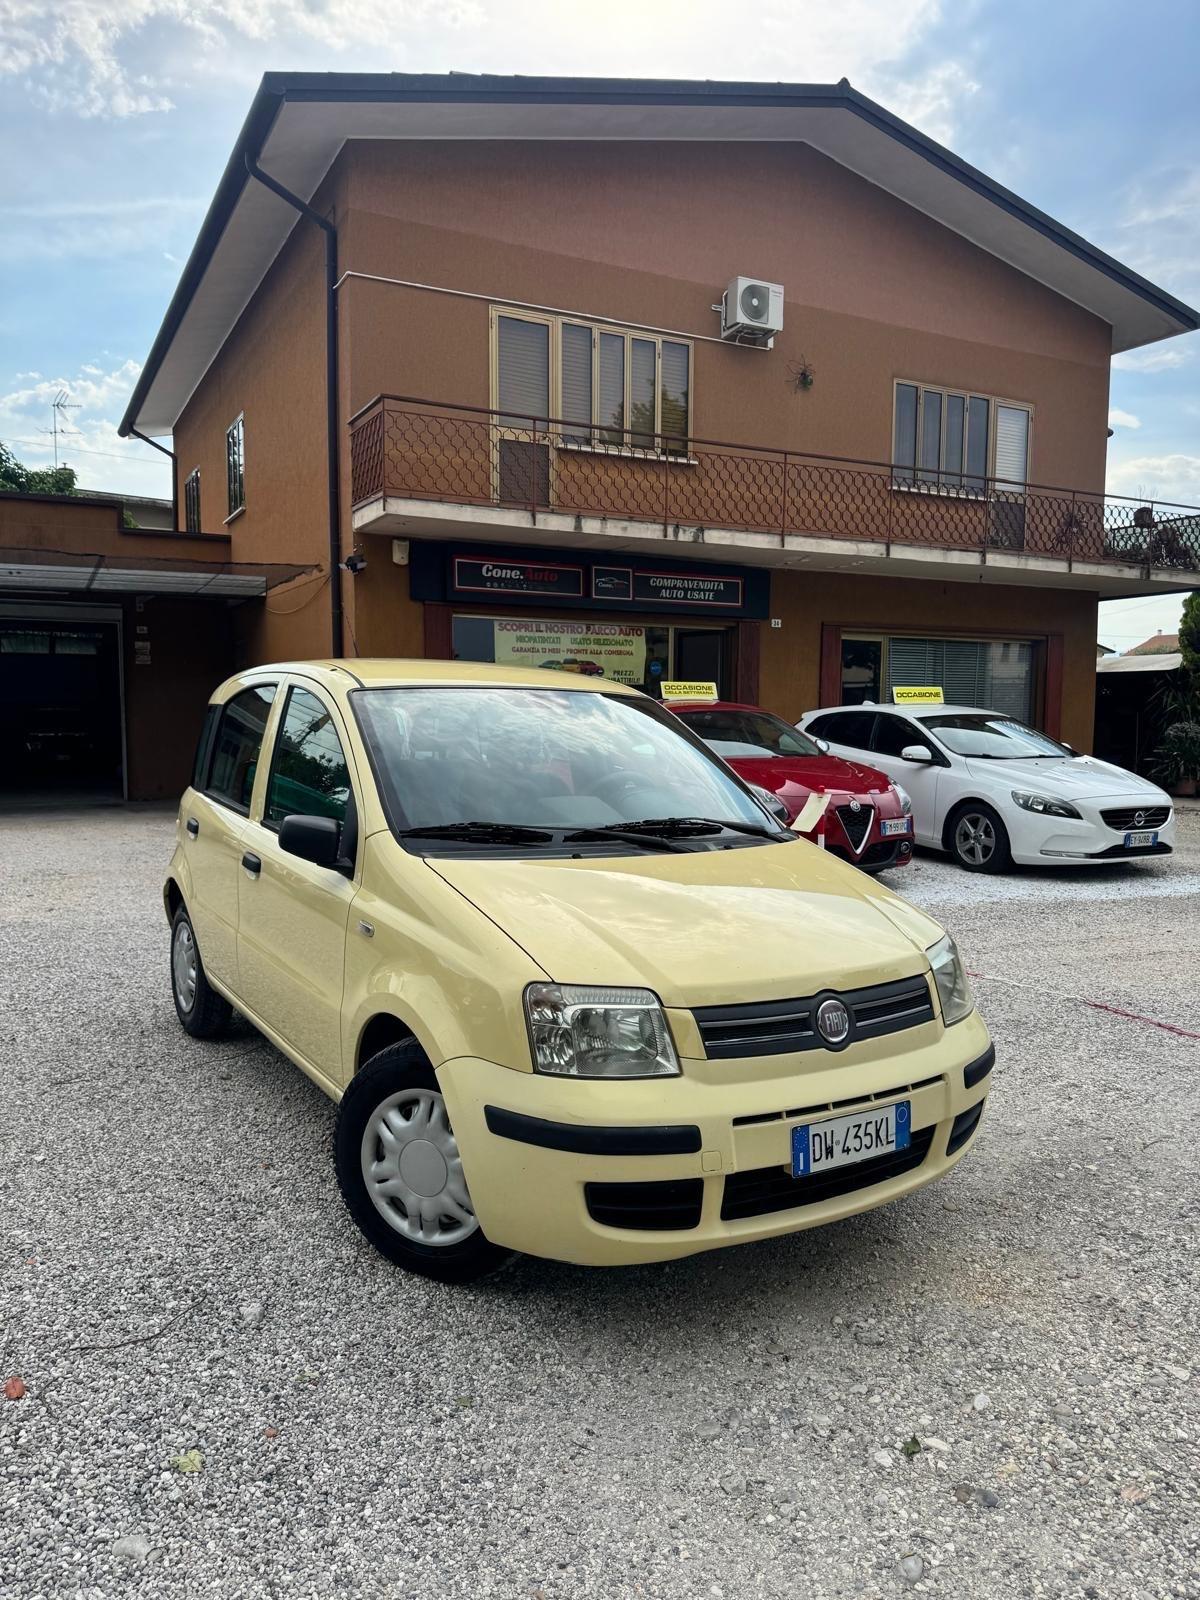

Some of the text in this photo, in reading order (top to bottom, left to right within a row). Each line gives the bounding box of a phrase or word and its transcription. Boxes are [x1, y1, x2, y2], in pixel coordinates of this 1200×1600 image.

[650, 577, 725, 590] COMPRAVENDITA
[659, 588, 715, 600] AUTO USATE
[498, 622, 643, 636] SCOPRI IL NOSTRO PARCO AUTO
[570, 637, 592, 645] USATO
[511, 646, 540, 654] GARANZIA
[825, 1011, 843, 1033] FIAT
